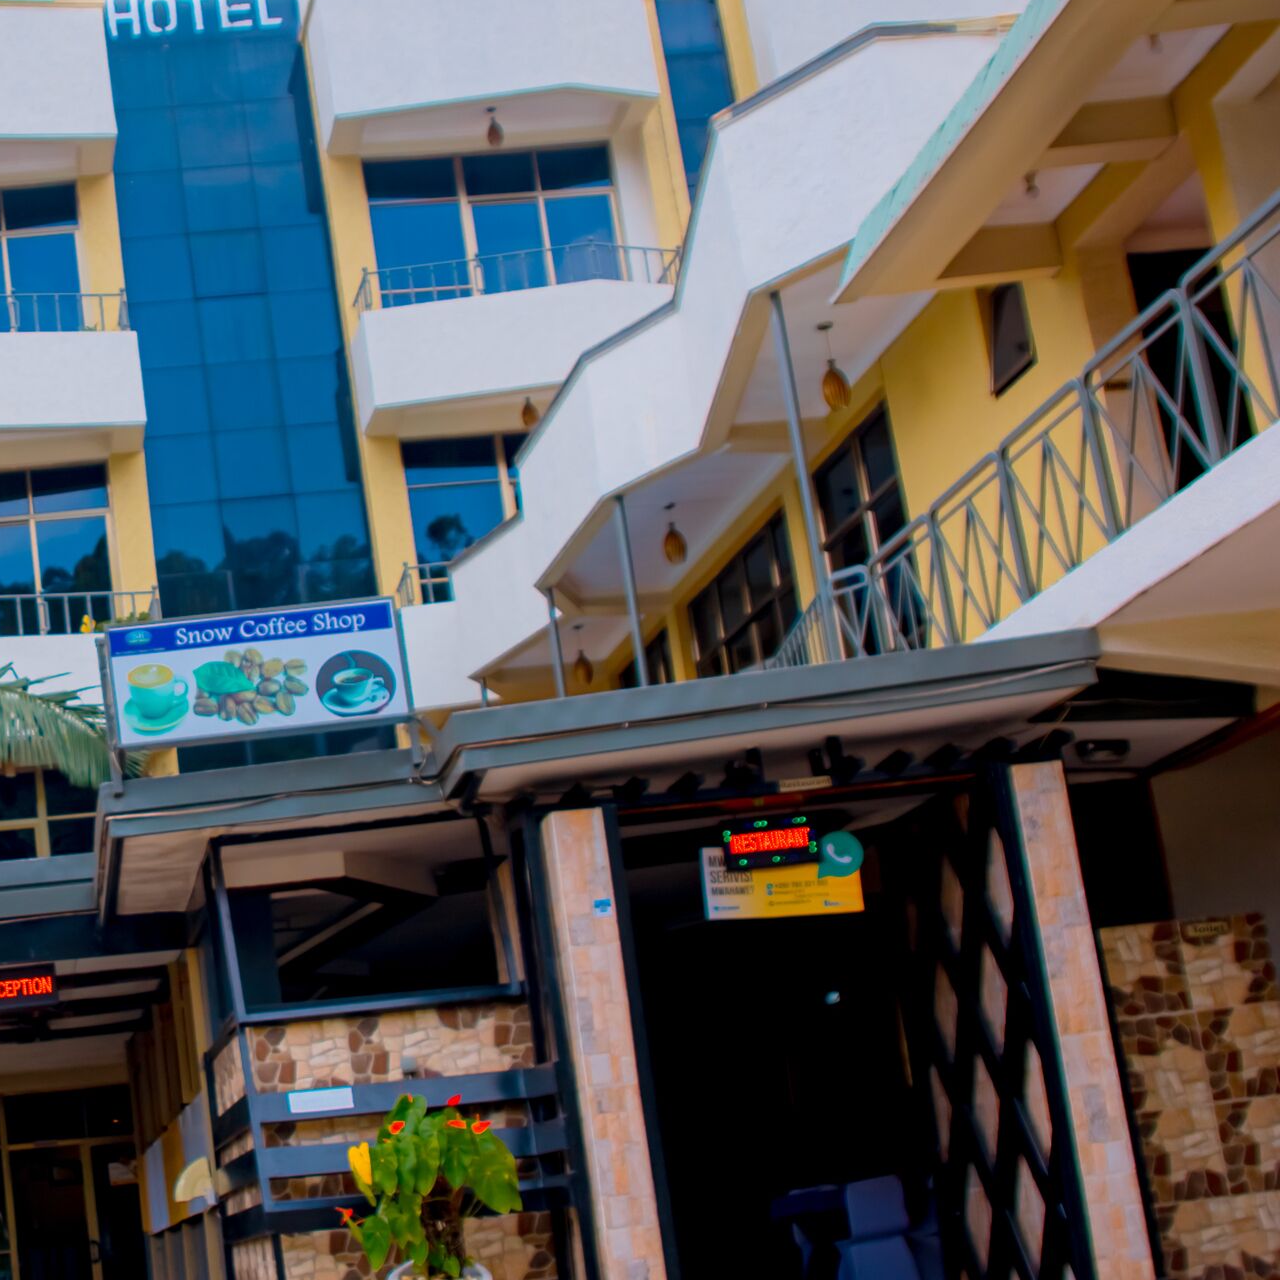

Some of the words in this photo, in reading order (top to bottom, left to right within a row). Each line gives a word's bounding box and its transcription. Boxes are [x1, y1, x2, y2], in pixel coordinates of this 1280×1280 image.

[176, 625, 234, 645] Snow
[240, 616, 307, 638] Coffee
[313, 611, 366, 632] Shop
[732, 826, 811, 853] RESTAURANT
